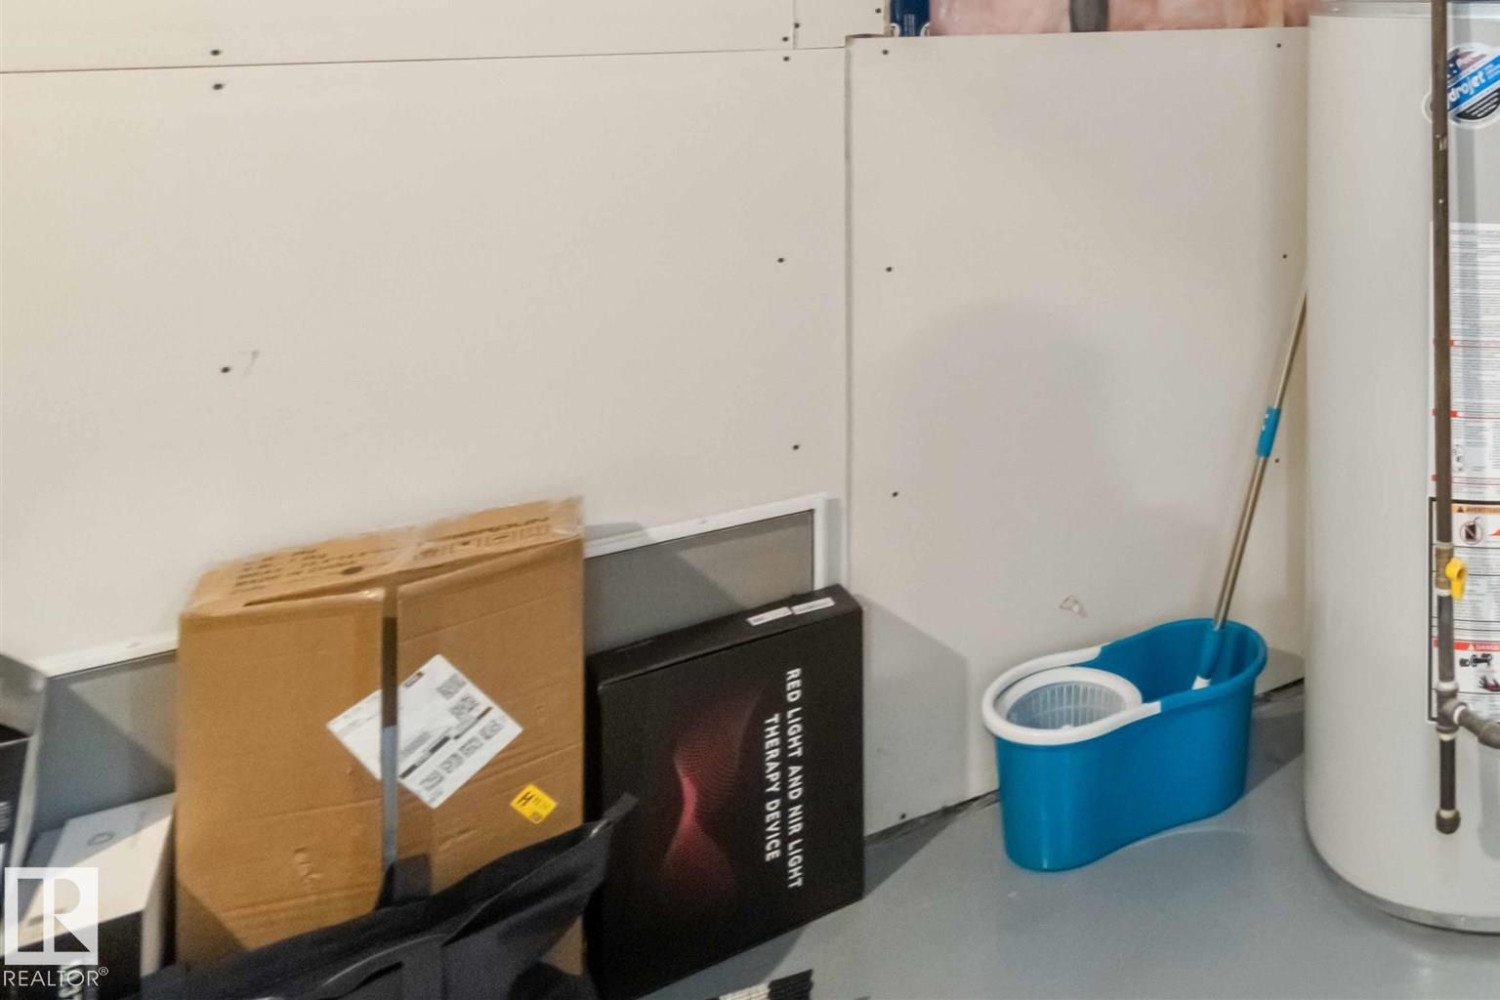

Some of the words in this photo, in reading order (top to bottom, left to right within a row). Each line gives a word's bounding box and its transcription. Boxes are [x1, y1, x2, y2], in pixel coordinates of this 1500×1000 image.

[786, 668, 802, 703] RED
[764, 713, 781, 793] THERAPY
[787, 707, 803, 758] LIGHT
[787, 765, 803, 800] AND
[765, 799, 781, 862] DEVICE
[787, 804, 804, 836] NIR
[787, 838, 804, 889] LIGHT
